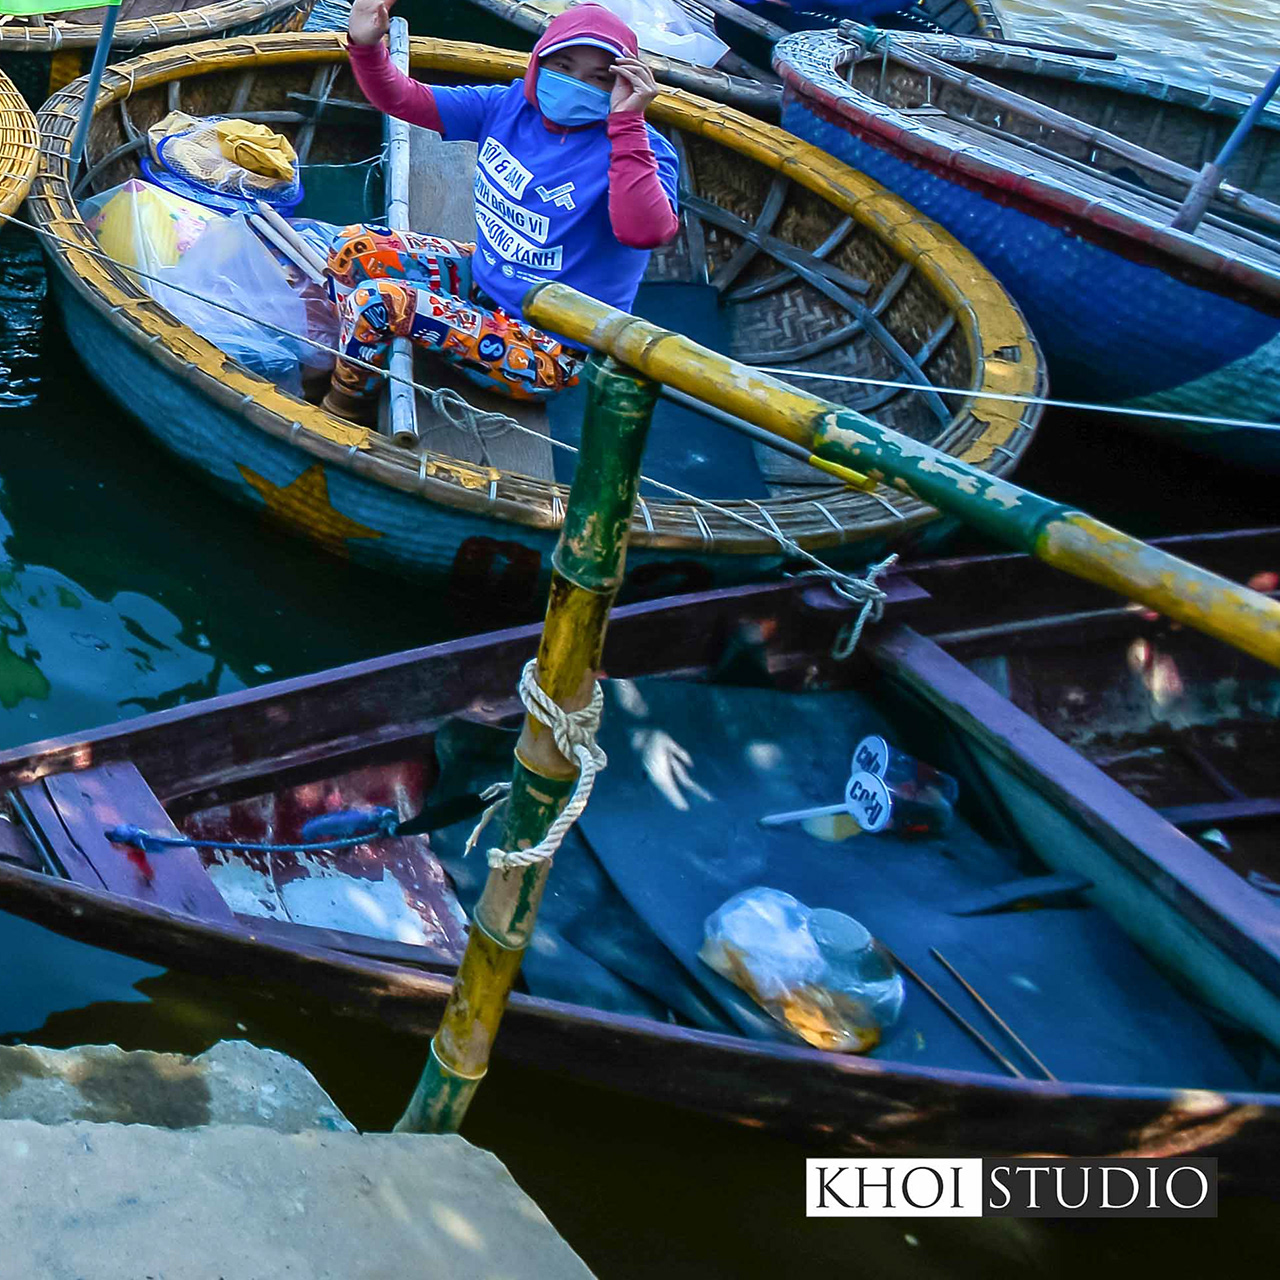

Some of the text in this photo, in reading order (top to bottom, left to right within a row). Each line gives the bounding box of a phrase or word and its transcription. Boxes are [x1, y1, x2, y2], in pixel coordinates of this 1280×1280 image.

[483, 142, 502, 164] TÔI
[494, 159, 512, 174] &
[529, 216, 543, 236] VÌ
[511, 243, 556, 266] XANH
